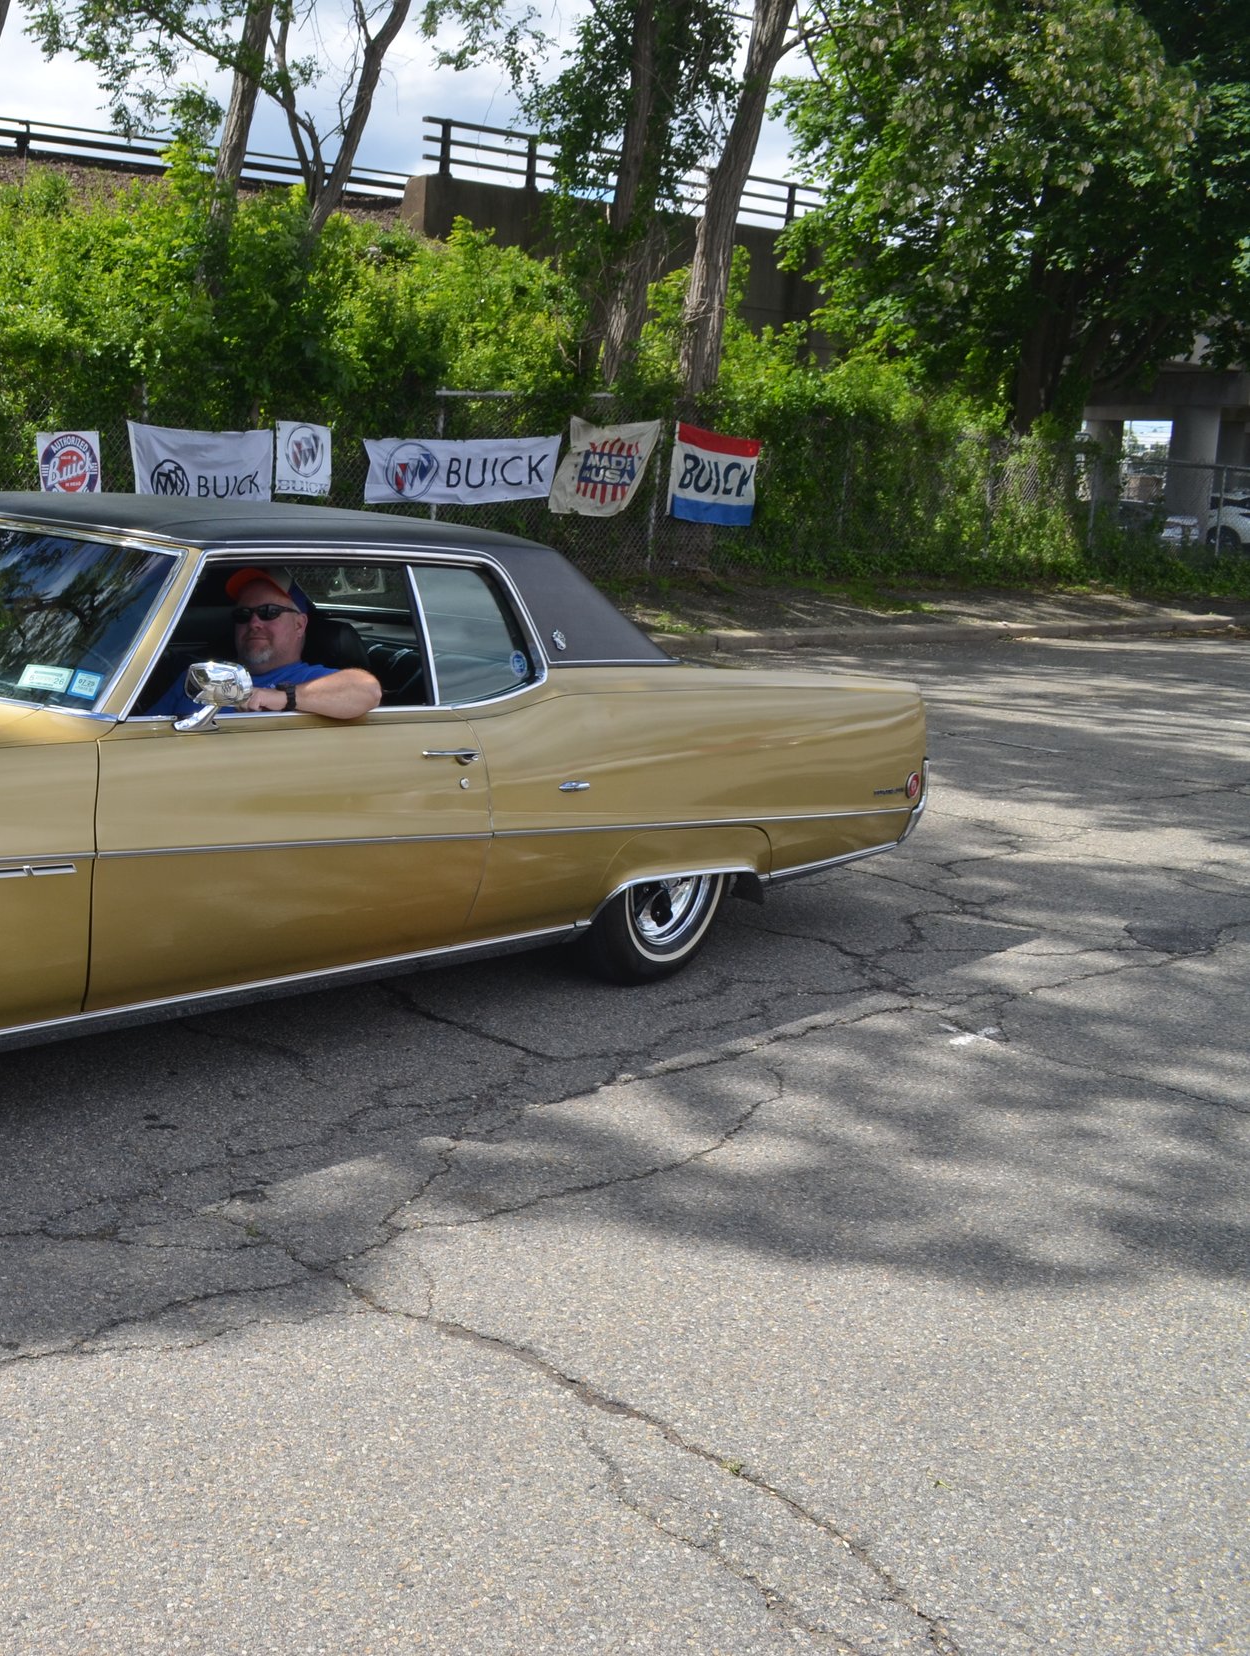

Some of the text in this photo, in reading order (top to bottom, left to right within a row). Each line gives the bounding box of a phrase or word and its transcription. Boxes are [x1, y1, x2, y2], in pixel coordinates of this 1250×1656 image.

[50, 436, 89, 453] AUTHORIZED
[46, 451, 93, 488] Buick
[446, 454, 549, 489] BUICK
[586, 453, 632, 470] MADE
[197, 471, 260, 498] BUICK
[590, 467, 632, 485] USA
[678, 453, 755, 497] BUICK
[277, 480, 329, 495] BUICK
